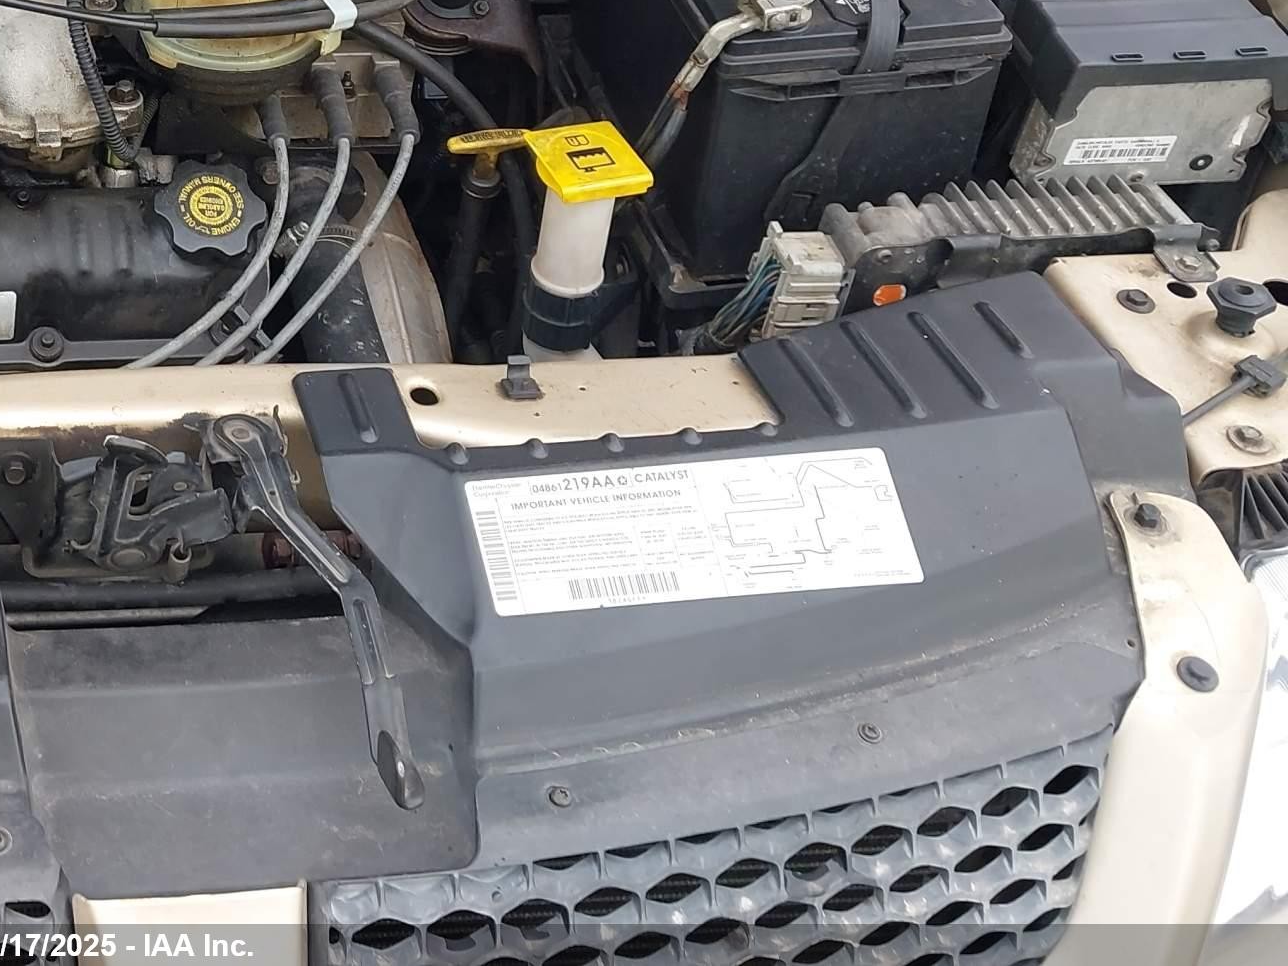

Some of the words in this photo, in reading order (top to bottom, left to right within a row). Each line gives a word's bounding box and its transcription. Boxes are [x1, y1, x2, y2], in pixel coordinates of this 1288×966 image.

[178, 178, 201, 203] MANUAL
[201, 176, 236, 192] OWNERS
[233, 192, 244, 210] SEE
[184, 212, 196, 227] OIL
[634, 470, 690, 483] CATALYST
[510, 499, 568, 510] IMPORTANT
[570, 495, 610, 504] VEHICLE
[613, 490, 681, 501] INFORMATION
